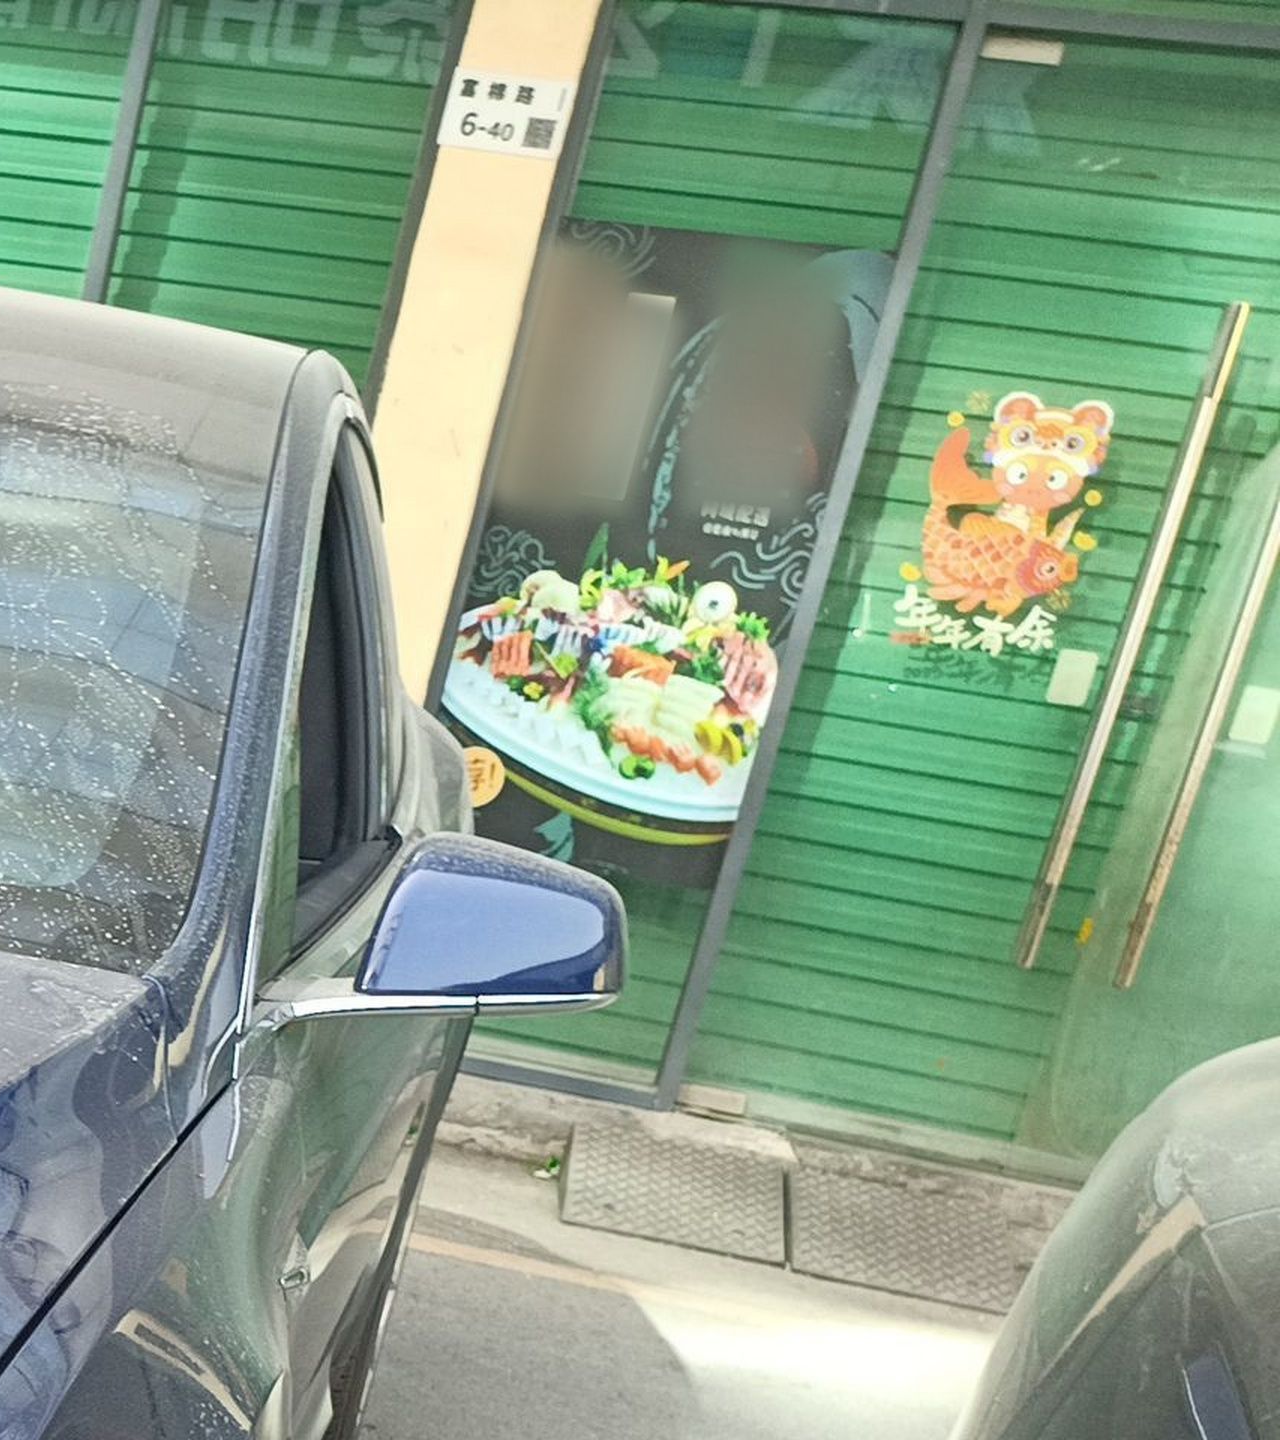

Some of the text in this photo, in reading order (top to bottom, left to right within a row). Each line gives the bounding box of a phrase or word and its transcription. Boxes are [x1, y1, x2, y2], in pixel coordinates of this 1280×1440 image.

[460, 111, 515, 142] 6-40
[893, 583, 1057, 658] 年年有余
